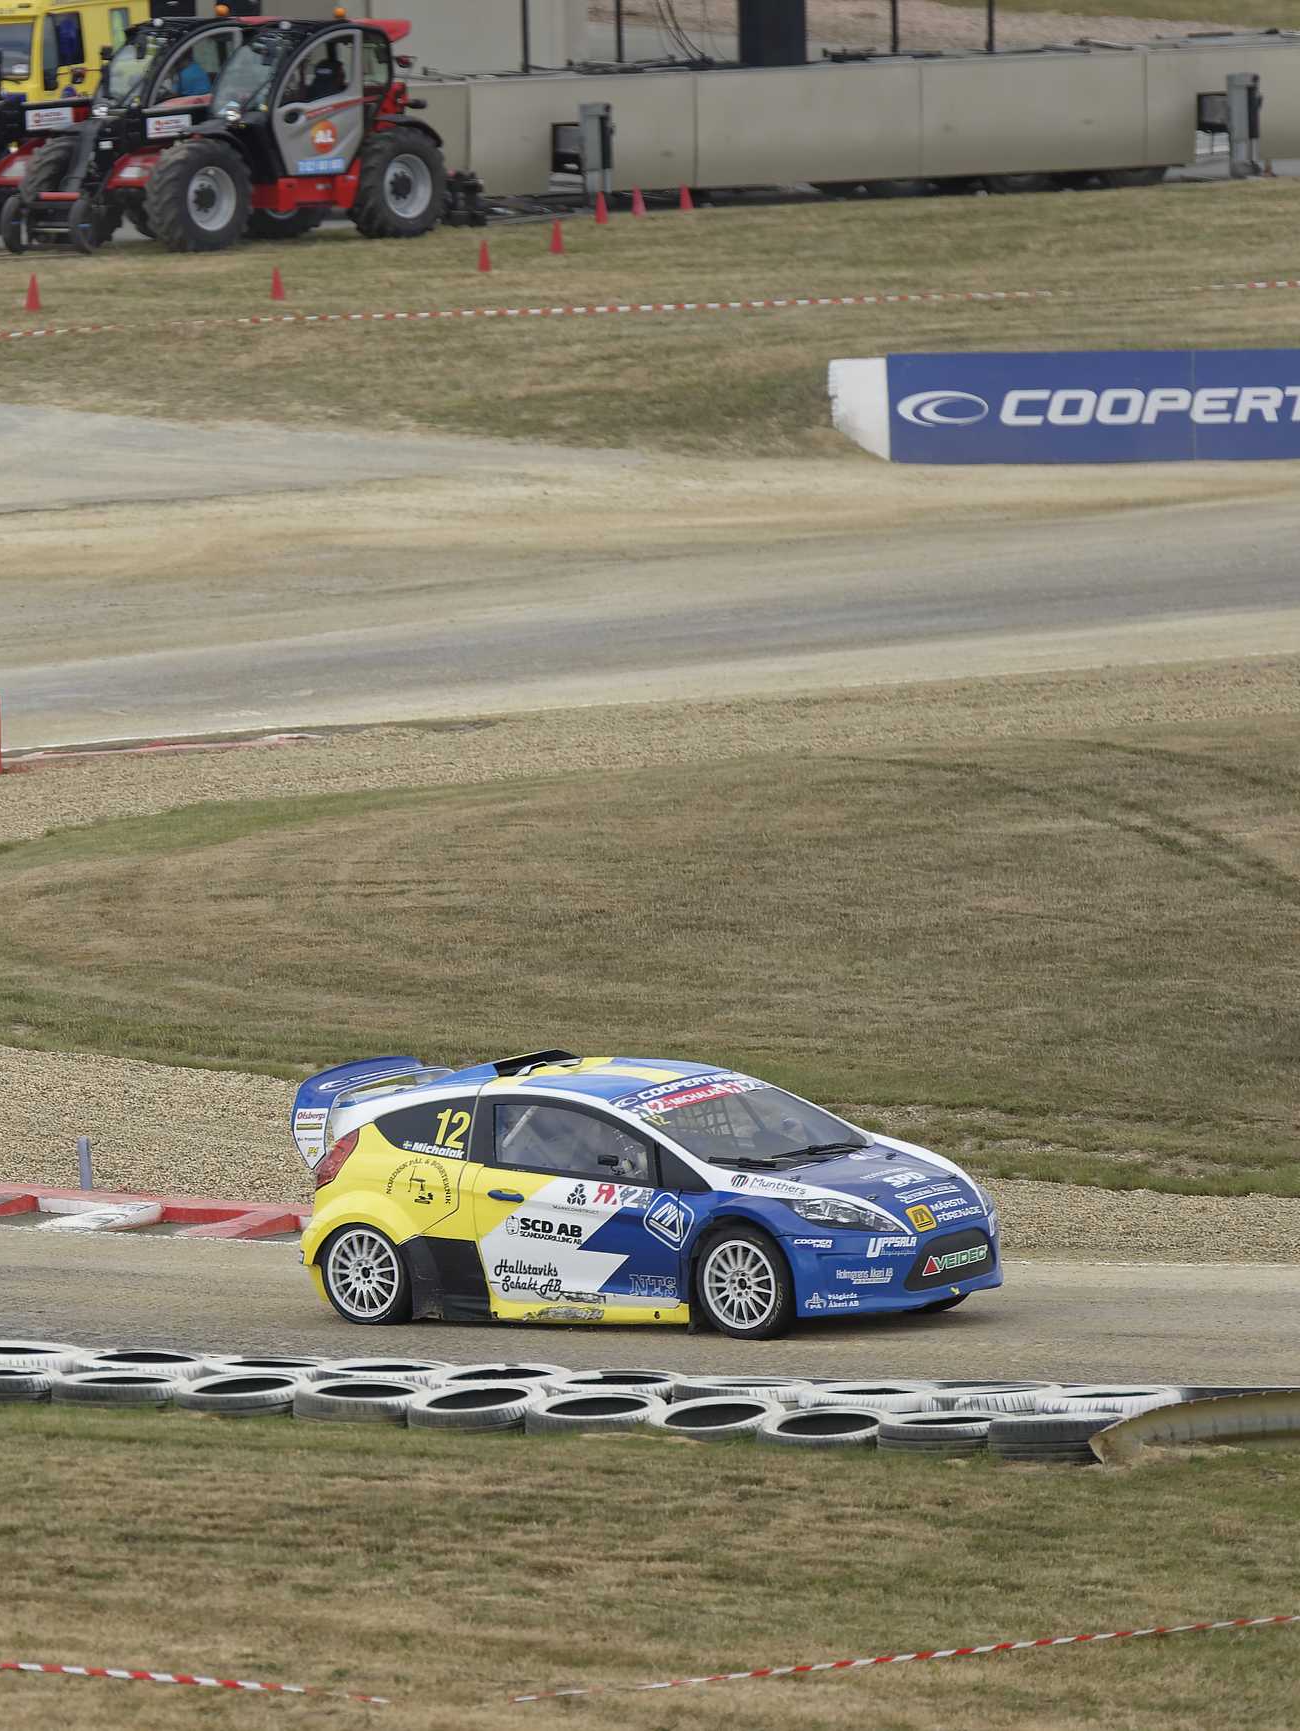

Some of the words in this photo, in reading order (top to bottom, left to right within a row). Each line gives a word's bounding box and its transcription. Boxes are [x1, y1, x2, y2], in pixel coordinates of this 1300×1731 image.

[435, 1108, 471, 1149] 12
[750, 1177, 808, 1195] Munthers
[930, 1197, 968, 1212] MÅRSTA
[936, 1205, 983, 1222] FÖRENADE
[520, 1217, 554, 1233] SCD
[556, 1222, 583, 1238] AB
[934, 1243, 988, 1271] VEIDEC
[494, 1259, 558, 1277] Hallstaviks
[540, 1278, 562, 1294] AB
[628, 1274, 678, 1298] NTS
